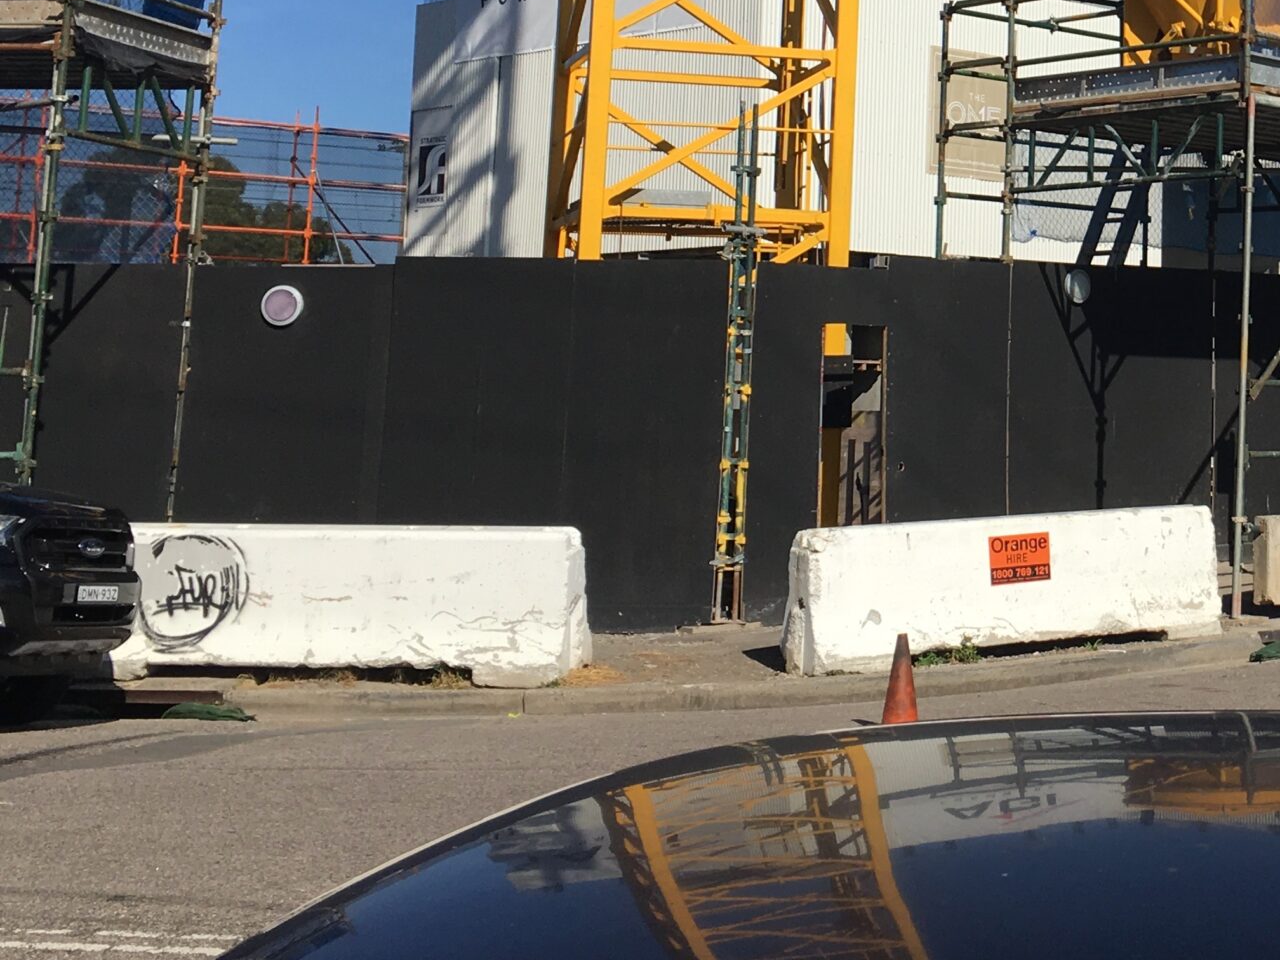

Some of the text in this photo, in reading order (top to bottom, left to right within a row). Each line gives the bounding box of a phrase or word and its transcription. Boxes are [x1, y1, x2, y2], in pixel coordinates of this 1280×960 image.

[991, 537, 1047, 553] Orange
[1006, 553, 1028, 563] HIRE
[992, 569, 1013, 579] 1800
[1034, 565, 1049, 575] 121
